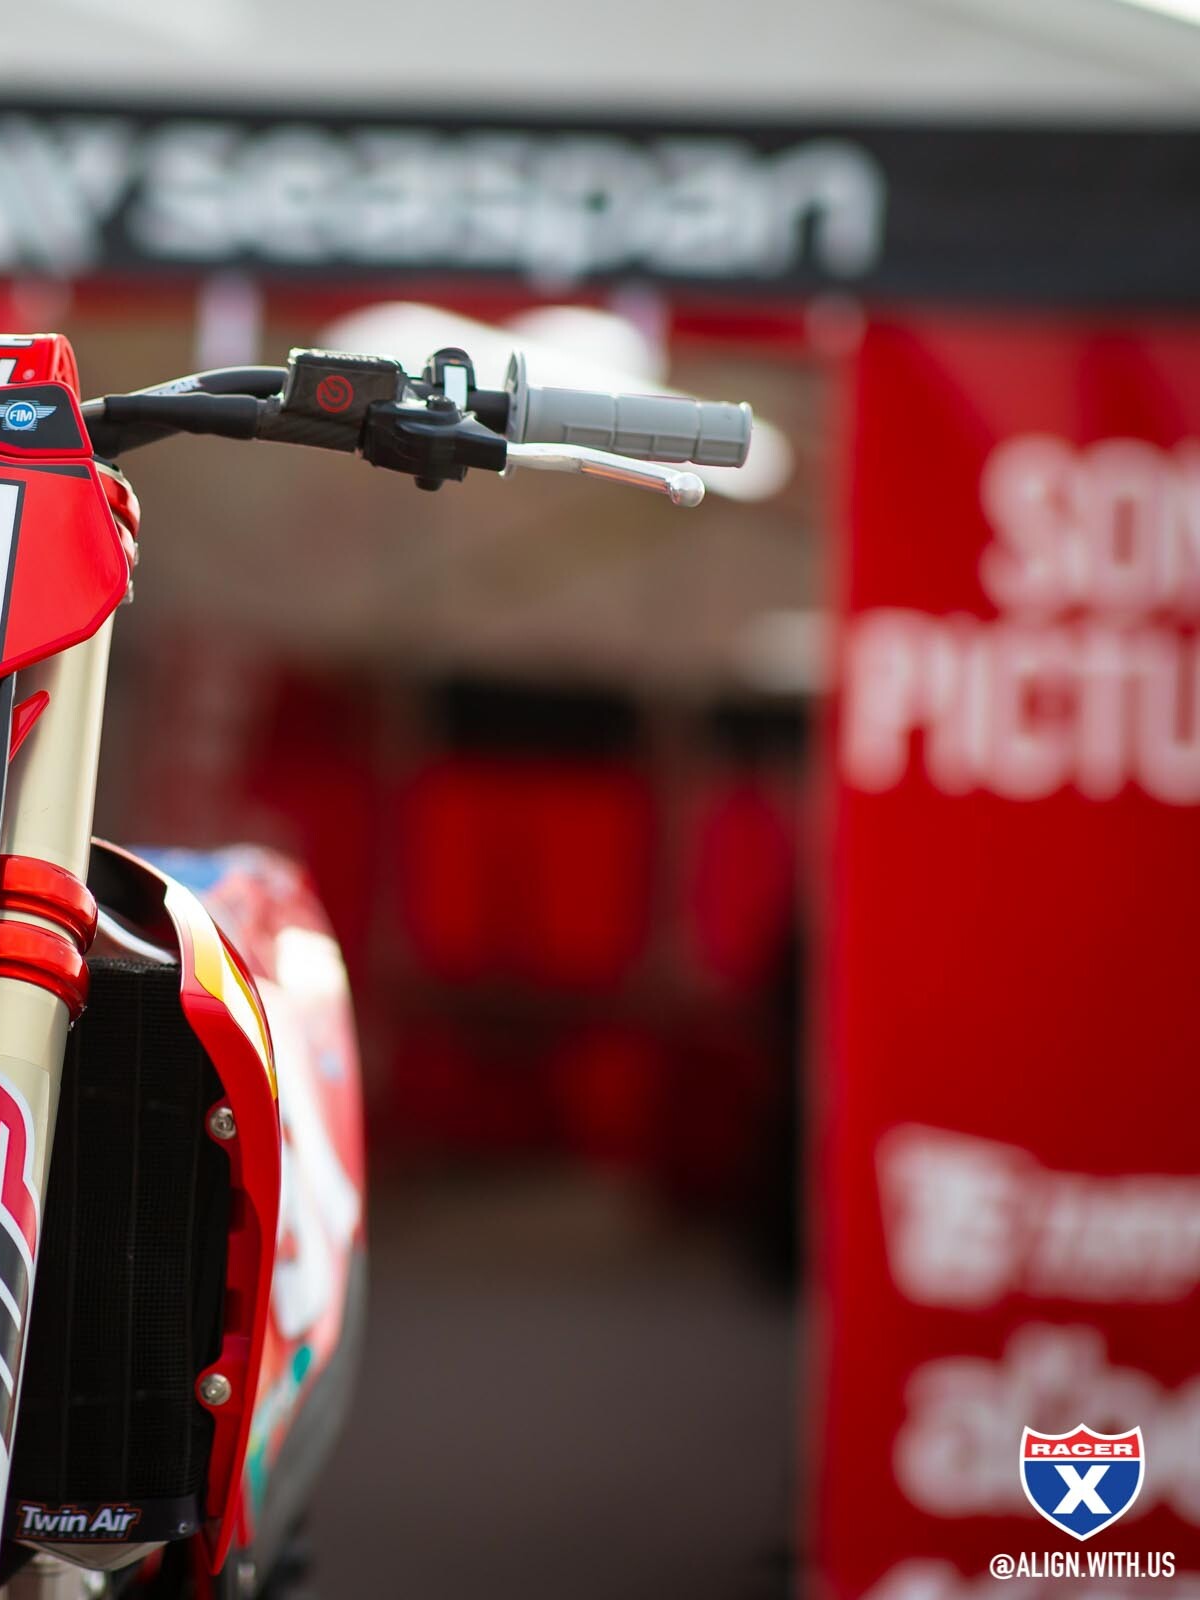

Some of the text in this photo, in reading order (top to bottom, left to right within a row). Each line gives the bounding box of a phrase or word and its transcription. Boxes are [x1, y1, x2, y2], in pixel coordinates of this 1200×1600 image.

[125, 118, 885, 286] seaspan
[8, 408, 34, 423] FIM
[20, 1504, 137, 1533] Twin Air
